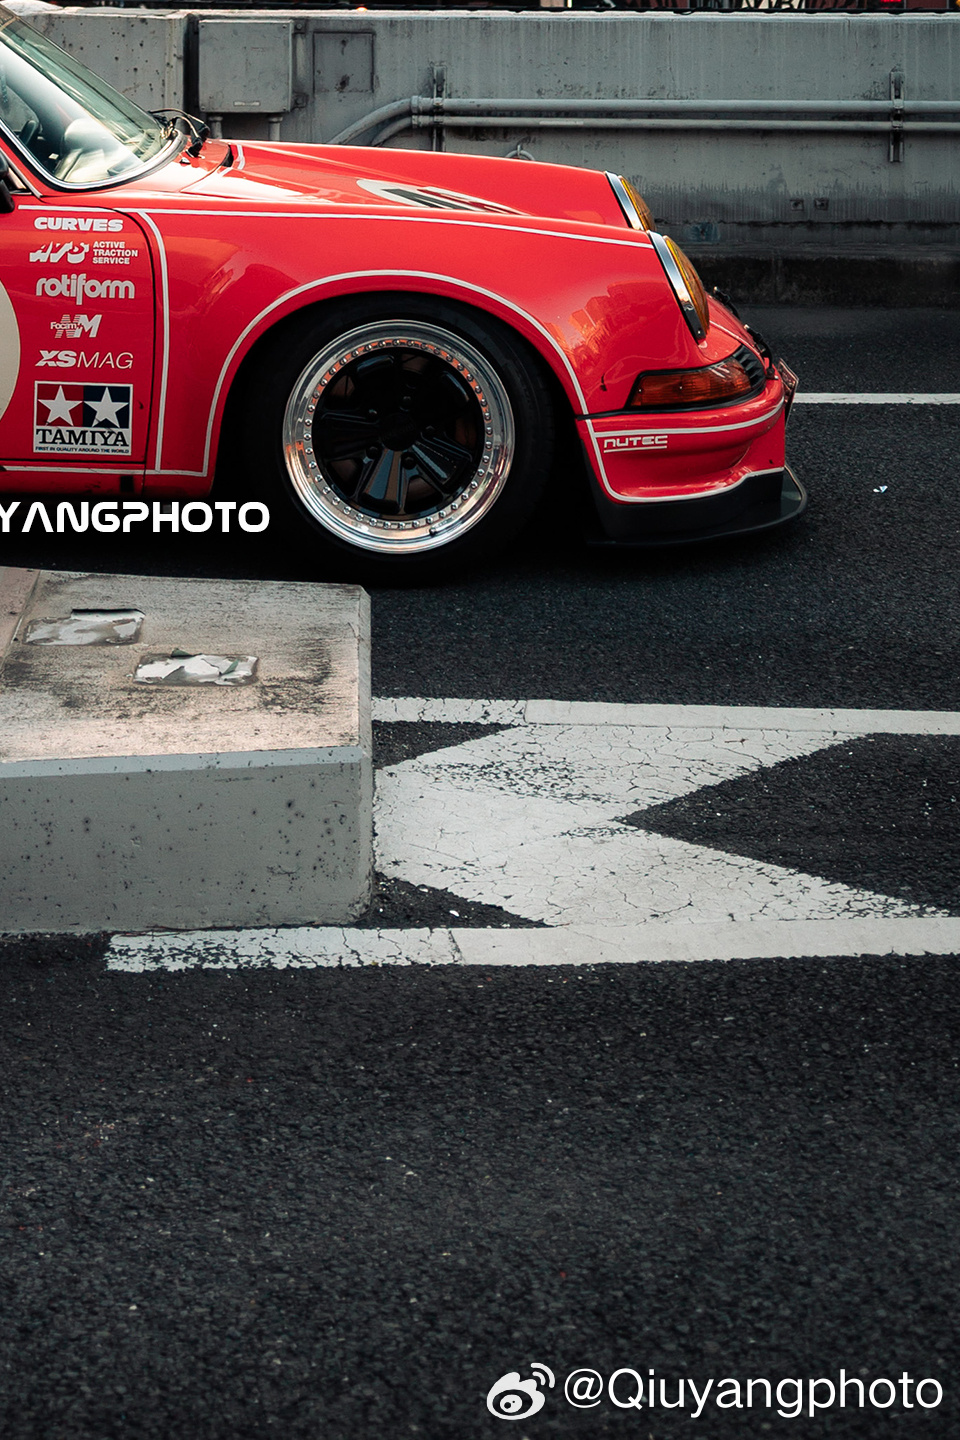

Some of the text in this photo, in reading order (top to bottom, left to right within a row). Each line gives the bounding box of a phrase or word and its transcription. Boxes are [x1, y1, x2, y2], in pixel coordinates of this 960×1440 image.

[34, 217, 123, 232] CURVES
[93, 241, 125, 249] ACTIVE
[93, 249, 138, 257] TRACTION
[36, 273, 135, 306] rotiform
[36, 428, 130, 447] TAMIYA
